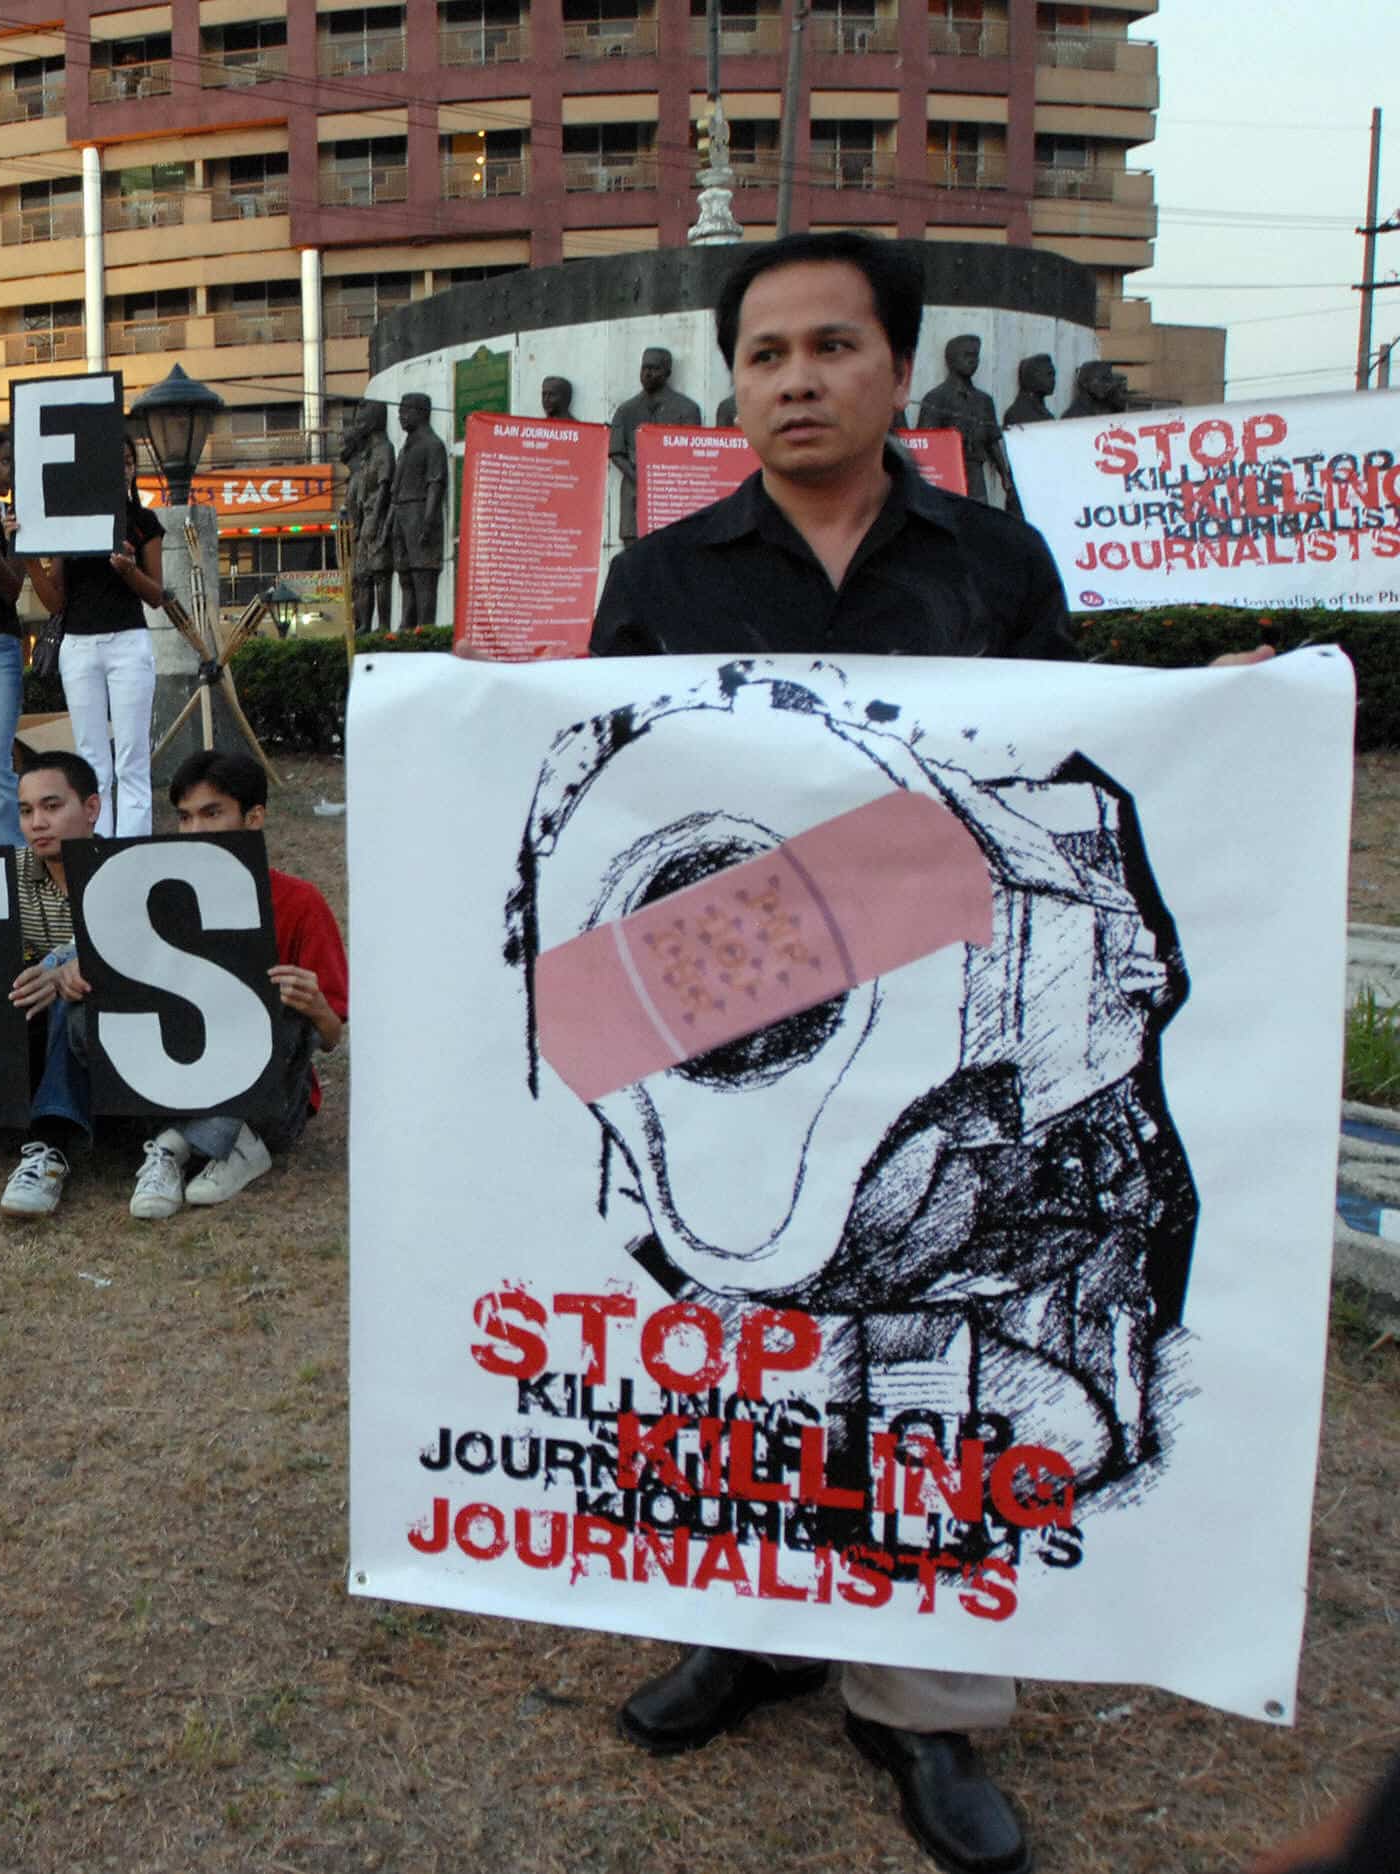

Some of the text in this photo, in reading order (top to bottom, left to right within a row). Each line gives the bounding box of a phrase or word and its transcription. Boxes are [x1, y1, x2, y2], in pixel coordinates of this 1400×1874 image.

[494, 424, 579, 442] SLAIN JOURNALISTS
[664, 435, 749, 449] SLAIN JOURNALISTS
[1094, 413, 1287, 475] STOP
[1349, 592, 1373, 604] the
[470, 1286, 822, 1401] STOP
[615, 1408, 1075, 1529] KILLING
[407, 1497, 1018, 1622] JOURNALISTS
